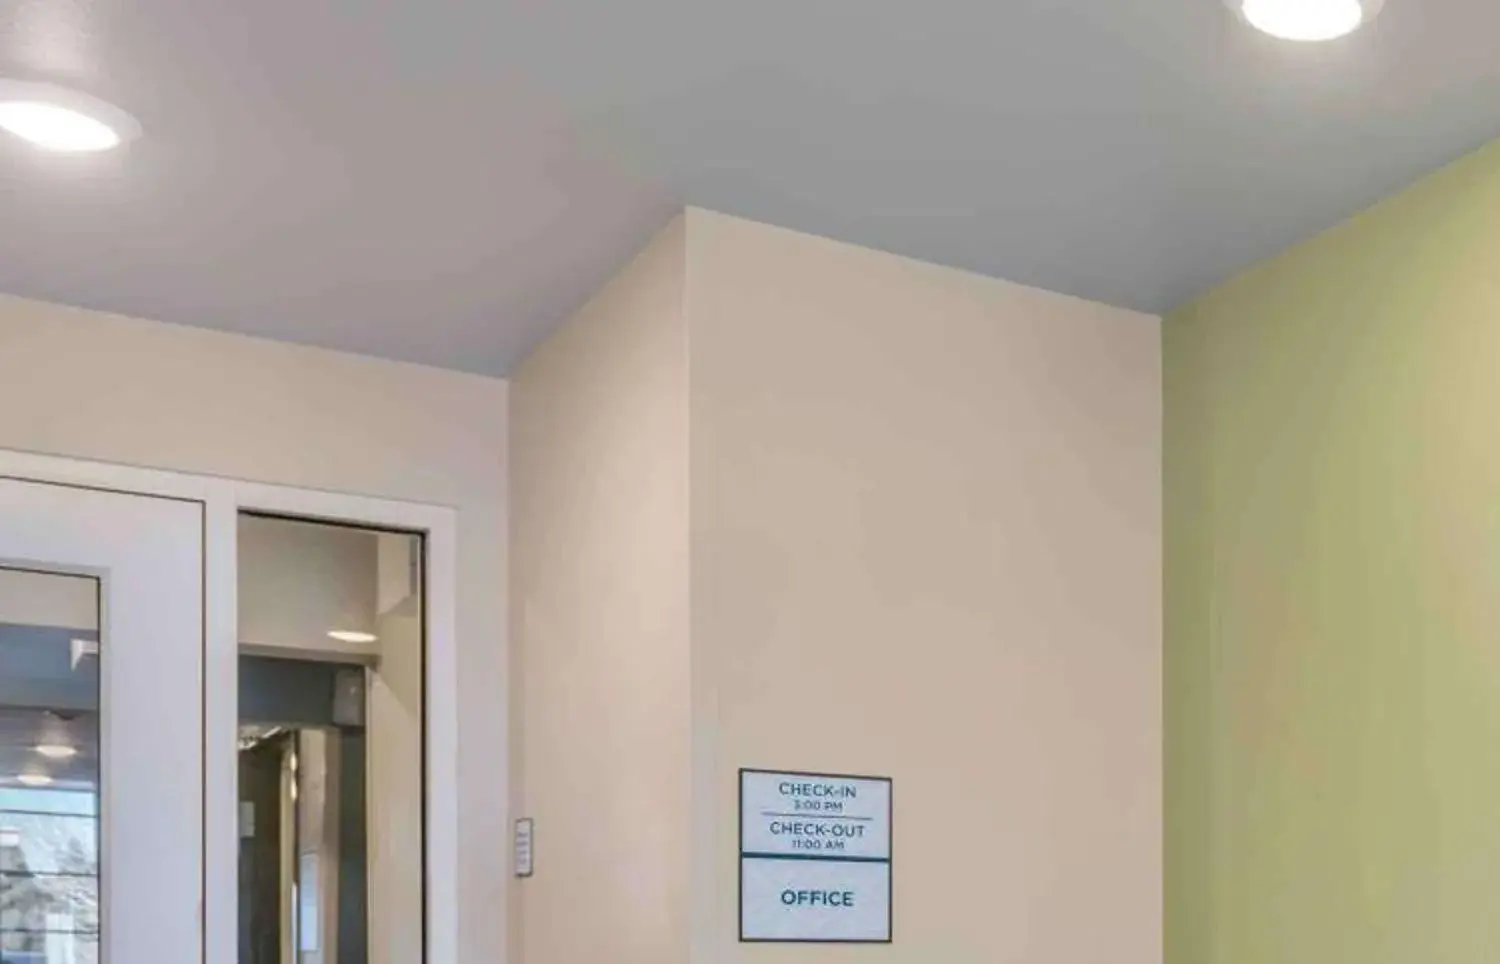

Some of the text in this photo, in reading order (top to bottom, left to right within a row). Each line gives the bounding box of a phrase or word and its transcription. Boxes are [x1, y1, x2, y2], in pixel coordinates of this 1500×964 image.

[779, 782, 857, 798] CHECK-IN
[824, 801, 843, 812] PM
[769, 821, 866, 838] CHECK-OUT
[825, 840, 845, 849] AM
[781, 889, 856, 907] OFFICE
